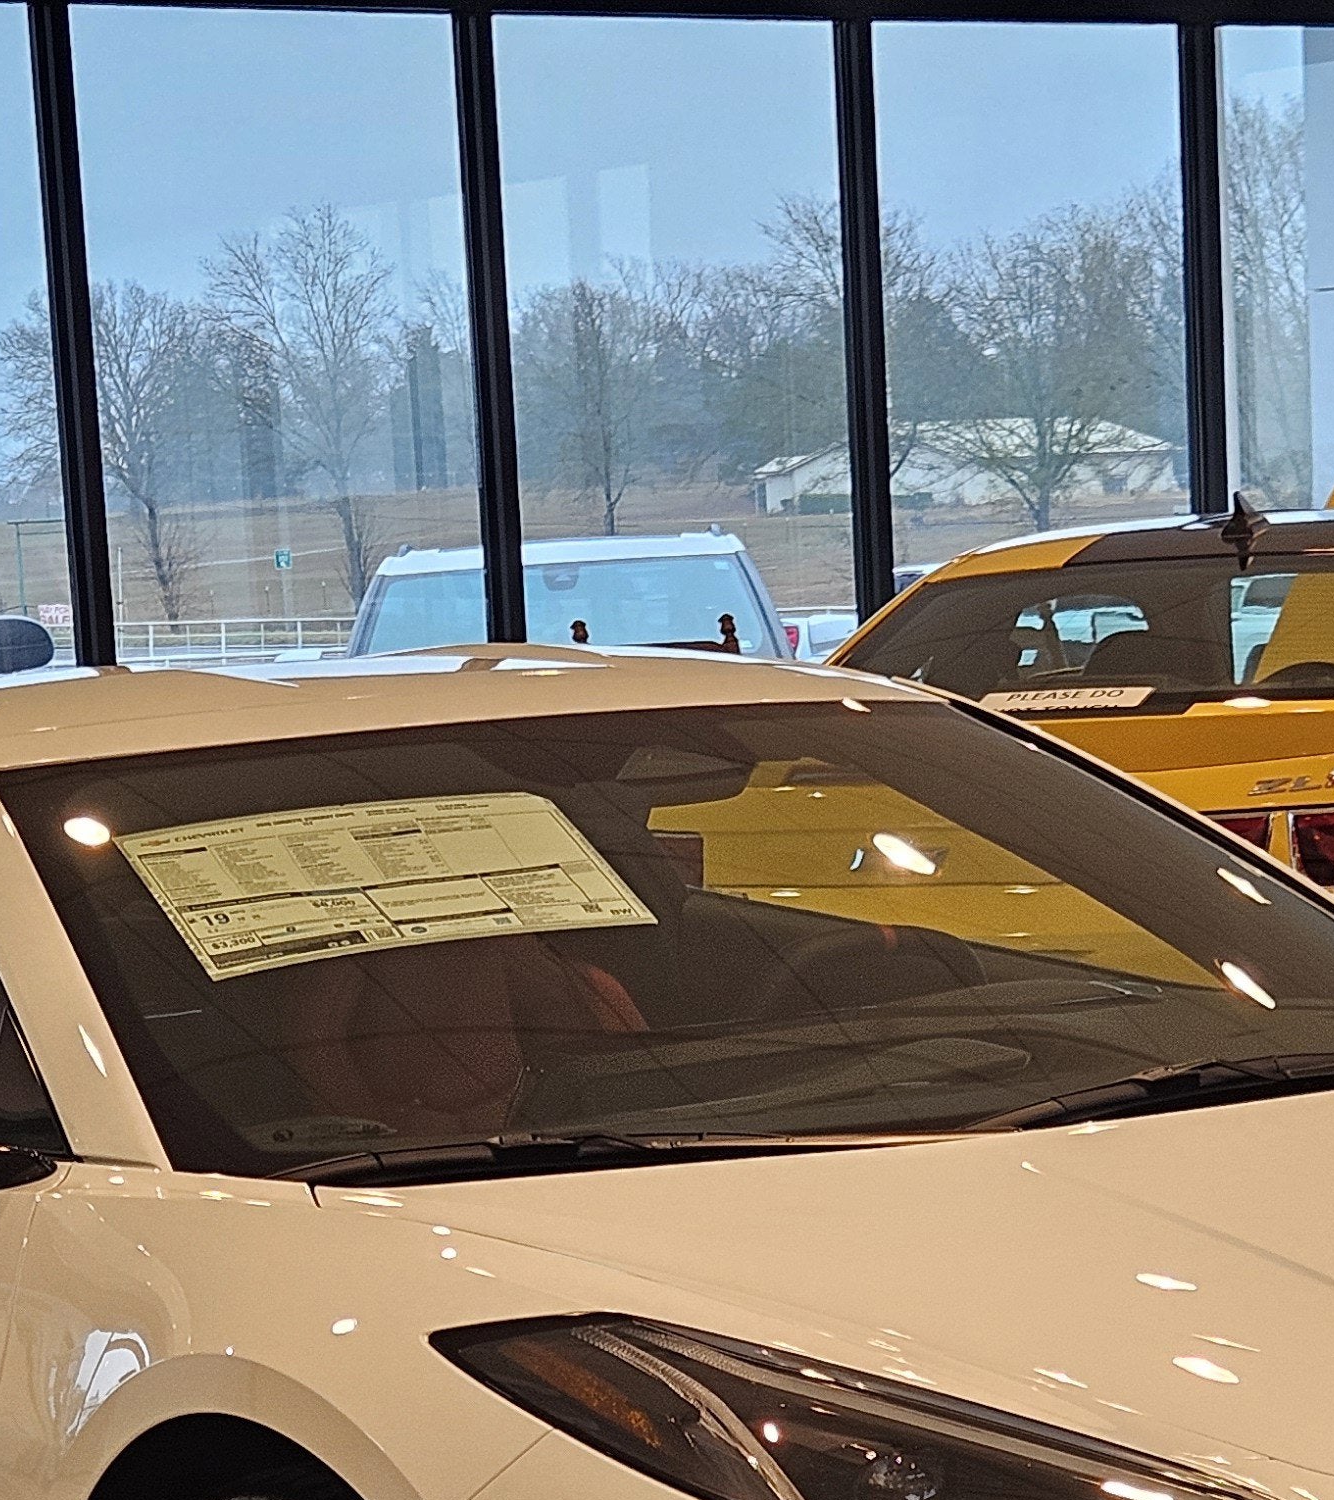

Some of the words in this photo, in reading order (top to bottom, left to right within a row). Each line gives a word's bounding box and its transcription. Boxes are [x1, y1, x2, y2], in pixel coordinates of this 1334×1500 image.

[1007, 690, 1085, 702] PLEASE
[1089, 689, 1125, 699] DO
[200, 912, 230, 927] 19
